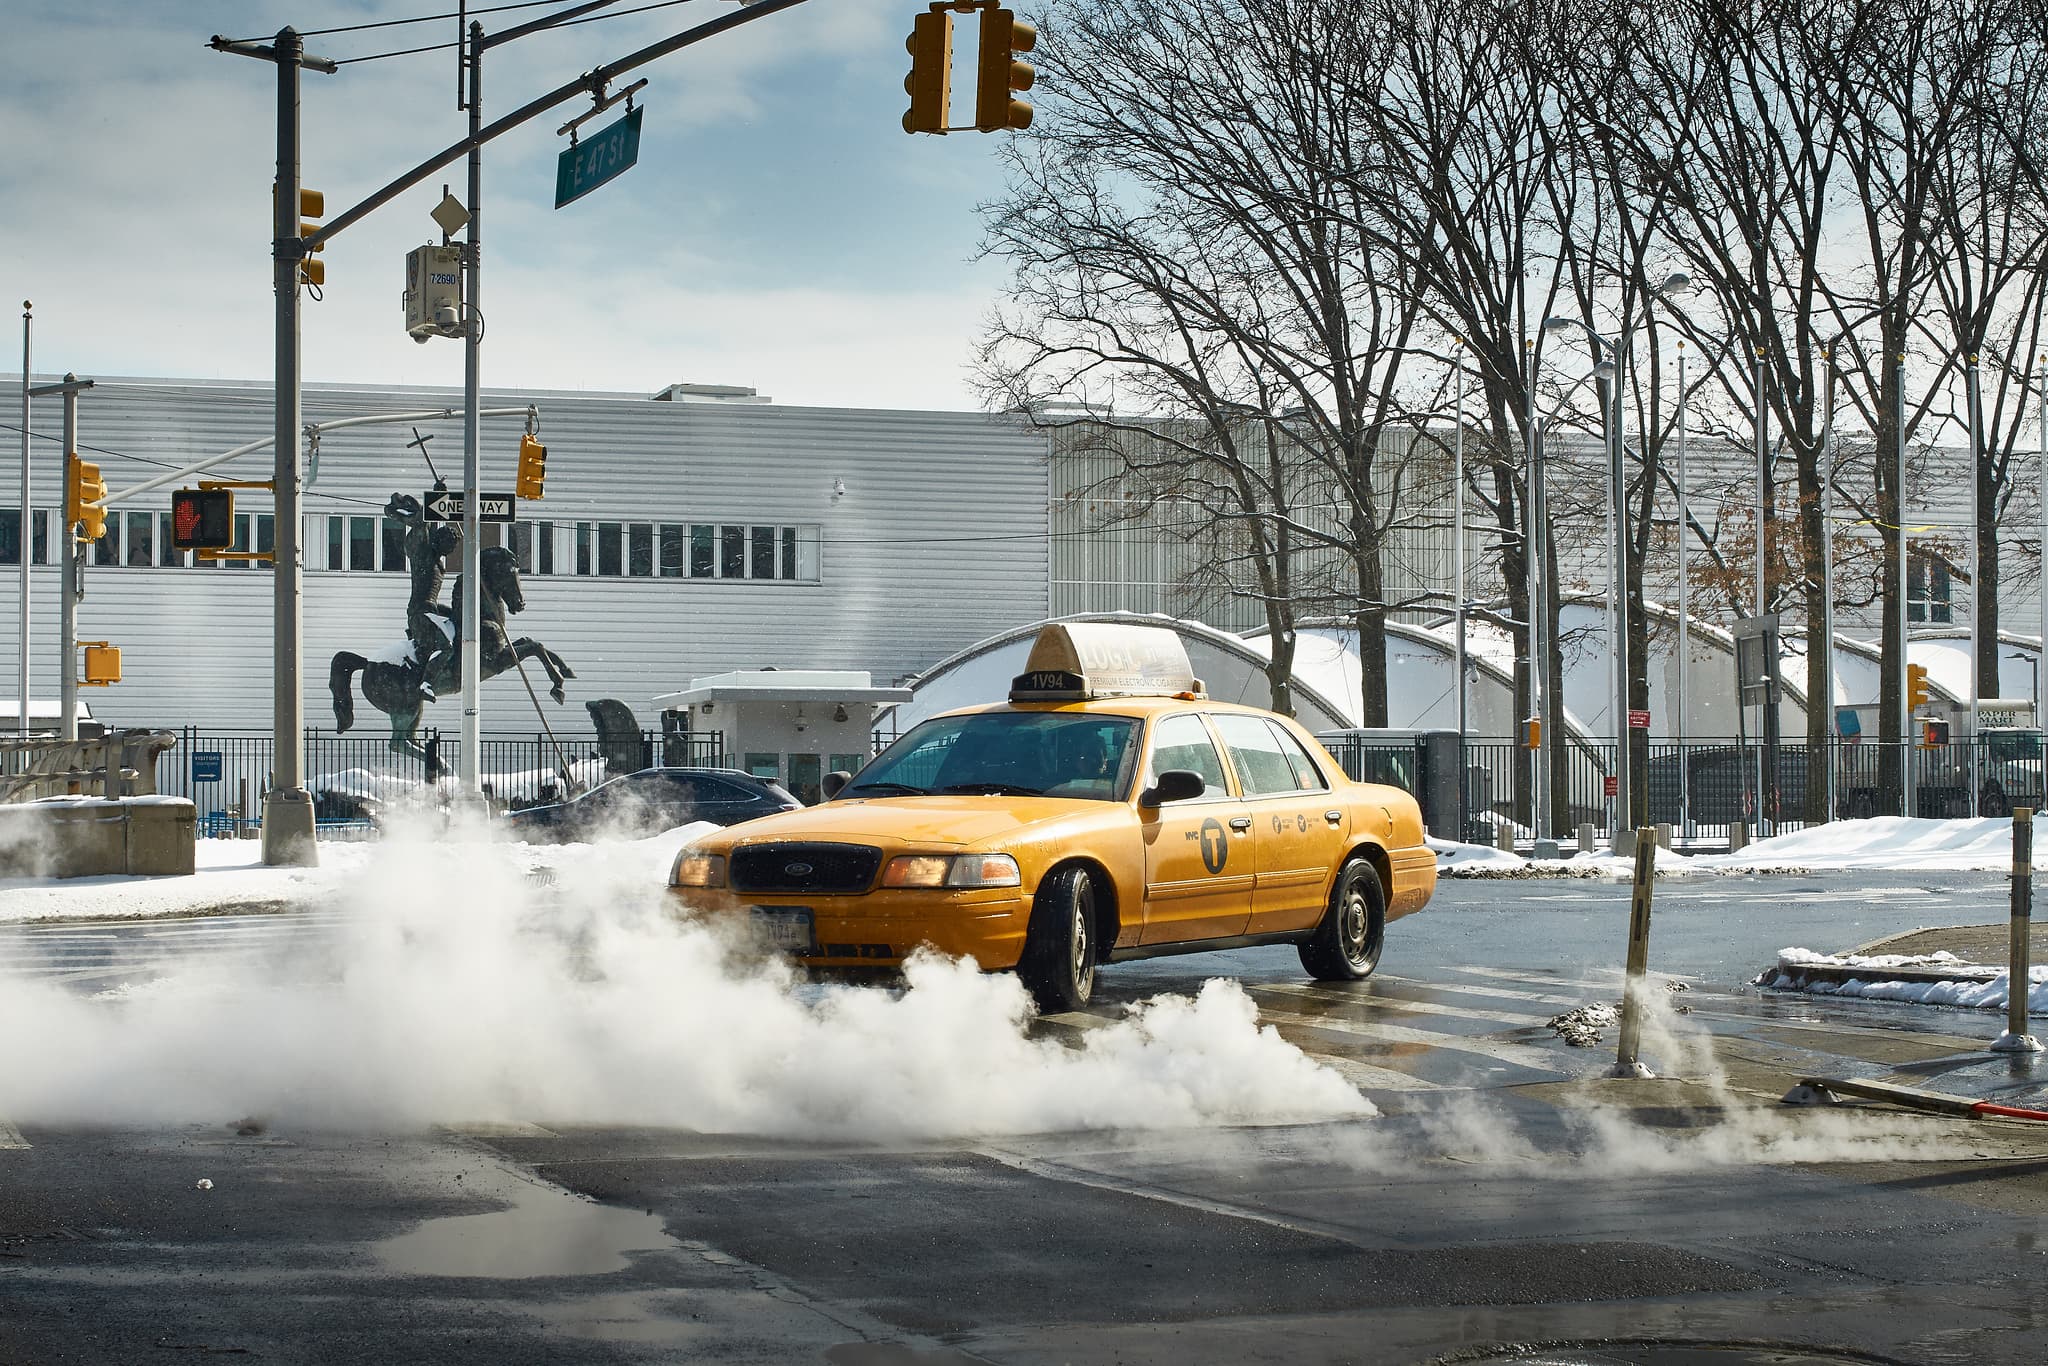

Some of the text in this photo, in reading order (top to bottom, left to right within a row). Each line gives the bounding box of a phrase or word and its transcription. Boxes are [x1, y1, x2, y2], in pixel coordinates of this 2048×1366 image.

[575, 131, 625, 187] E 47 St
[438, 501, 464, 513] ONE
[1031, 674, 1063, 689] 1V94
[1089, 676, 1118, 688] PREMIUM
[1119, 677, 1155, 688] ELECTRONIC
[1185, 828, 1221, 867] NYC T
